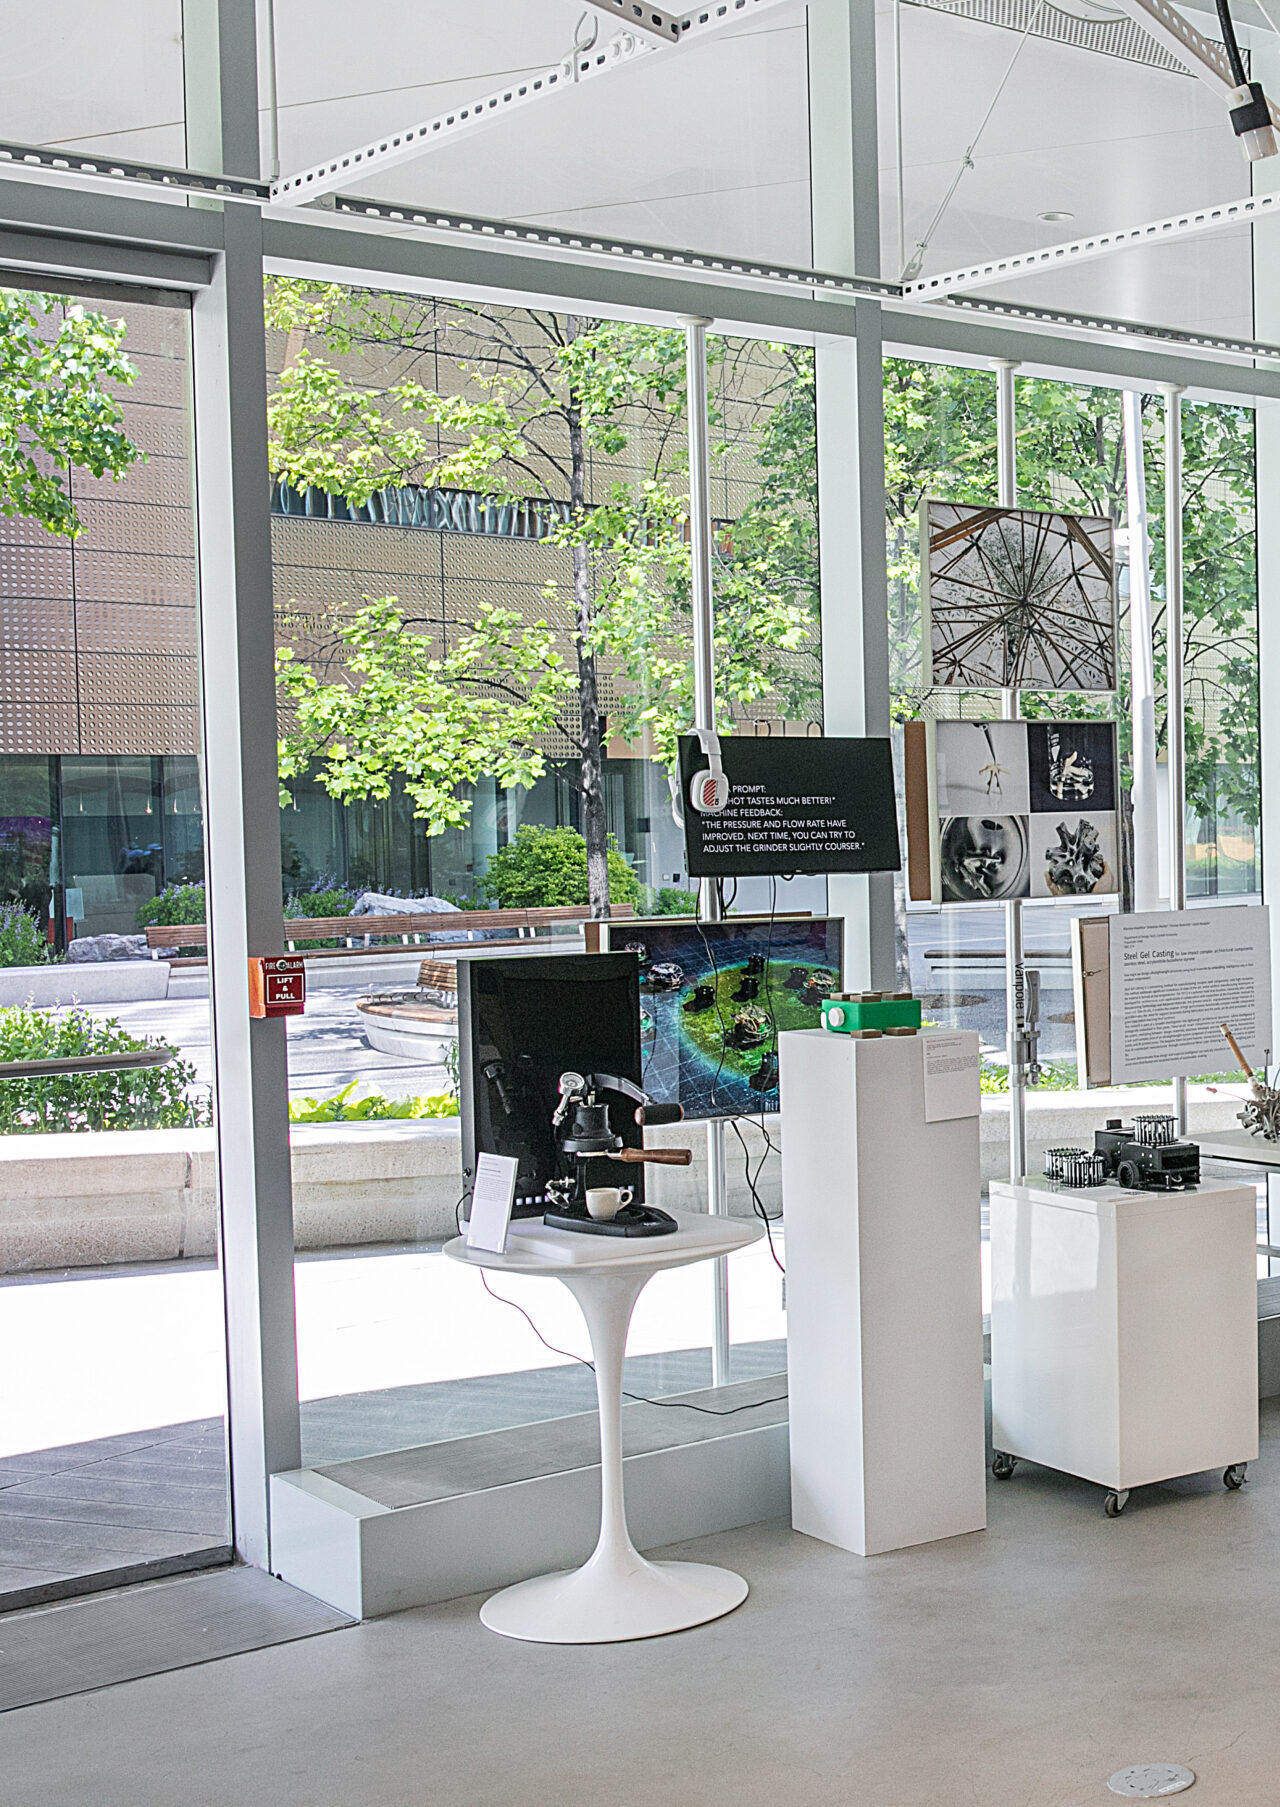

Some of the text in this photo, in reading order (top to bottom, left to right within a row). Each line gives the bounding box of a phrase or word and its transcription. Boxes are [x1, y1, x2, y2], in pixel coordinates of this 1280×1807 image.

[732, 785, 766, 793] PROMPT:
[727, 797, 745, 805] HOT
[746, 797, 775, 805] TASTES
[776, 797, 800, 805] MUCH
[740, 808, 783, 817] FEEDBACK:
[807, 820, 826, 828] RATE
[827, 819, 847, 827] HAVE
[770, 832, 791, 840] TIME,
[703, 844, 733, 852] ADJUST
[752, 844, 788, 852] GRINDER
[789, 843, 823, 851] SLIGHTLY
[1124, 952, 1138, 960] Steel
[1140, 951, 1150, 959] Gel
[1152, 950, 1174, 958] Casting
